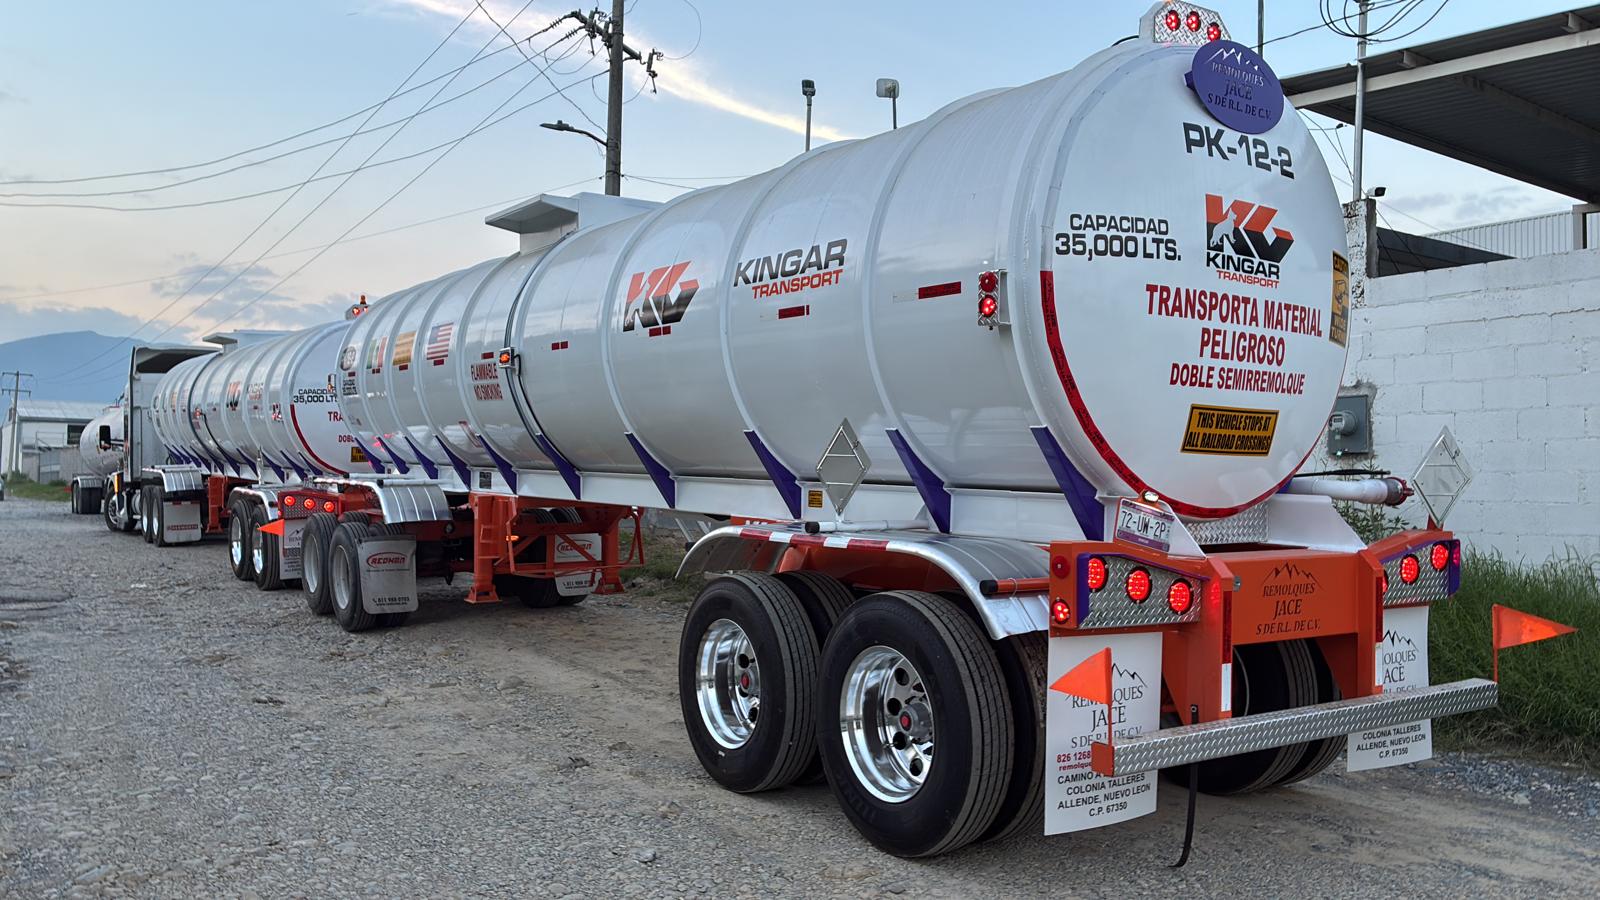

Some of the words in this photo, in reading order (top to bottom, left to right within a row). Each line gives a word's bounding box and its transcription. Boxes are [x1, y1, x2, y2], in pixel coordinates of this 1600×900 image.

[1212, 62, 1264, 87] REMOLQUES
[1224, 80, 1252, 100] JACE
[1183, 122, 1294, 179] PK-12-2
[1069, 213, 1168, 235] CAPACIDAD
[1055, 233, 1138, 261] 35,000
[1143, 236, 1181, 261] LTS.
[734, 239, 847, 287] KINGAR
[1206, 252, 1280, 280] KINGAR
[752, 269, 843, 299] TRANSPORT
[1216, 270, 1279, 289] TRANSPORT
[1146, 284, 1259, 327] TRANSPORTA
[1263, 300, 1322, 337] MATERIAL
[1200, 327, 1285, 366] PELIGROSO
[1169, 363, 1214, 388] DOBLE
[1217, 367, 1305, 396] SEMIRREMOLQUE
[1197, 411, 1215, 428] THIS
[1215, 413, 1242, 430] VEHICLE
[1242, 415, 1263, 431] STOPS
[1262, 416, 1272, 432] AT
[1185, 432, 1200, 447] ALL
[1200, 432, 1235, 449] RAILROAD
[1235, 434, 1271, 450] CROSSINGS
[1263, 583, 1316, 598] REMOLQUES
[1273, 599, 1303, 620] JACE
[1263, 622, 1276, 635] DE
[1294, 619, 1306, 632] DE
[1384, 649, 1416, 665] OLQUES
[1383, 666, 1405, 684] ACE
[1356, 740, 1388, 752] ALLENDE,
[1390, 736, 1411, 746] NUEVO
[1412, 733, 1426, 743] LEON
[1363, 729, 1392, 741] COLONIA
[1393, 724, 1421, 736] TALLERES
[1057, 753, 1071, 763] 826
[1392, 747, 1408, 757] 67350
[1057, 771, 1093, 785] CAMINO
[1066, 782, 1105, 796] COLONIA
[1108, 773, 1145, 788] TALLERES
[1057, 794, 1102, 809] ALLENDE,
[1104, 788, 1131, 801] NUEVO
[1132, 783, 1151, 795] LEON
[1089, 806, 1104, 817] C.P.
[1106, 801, 1128, 814] 67350
